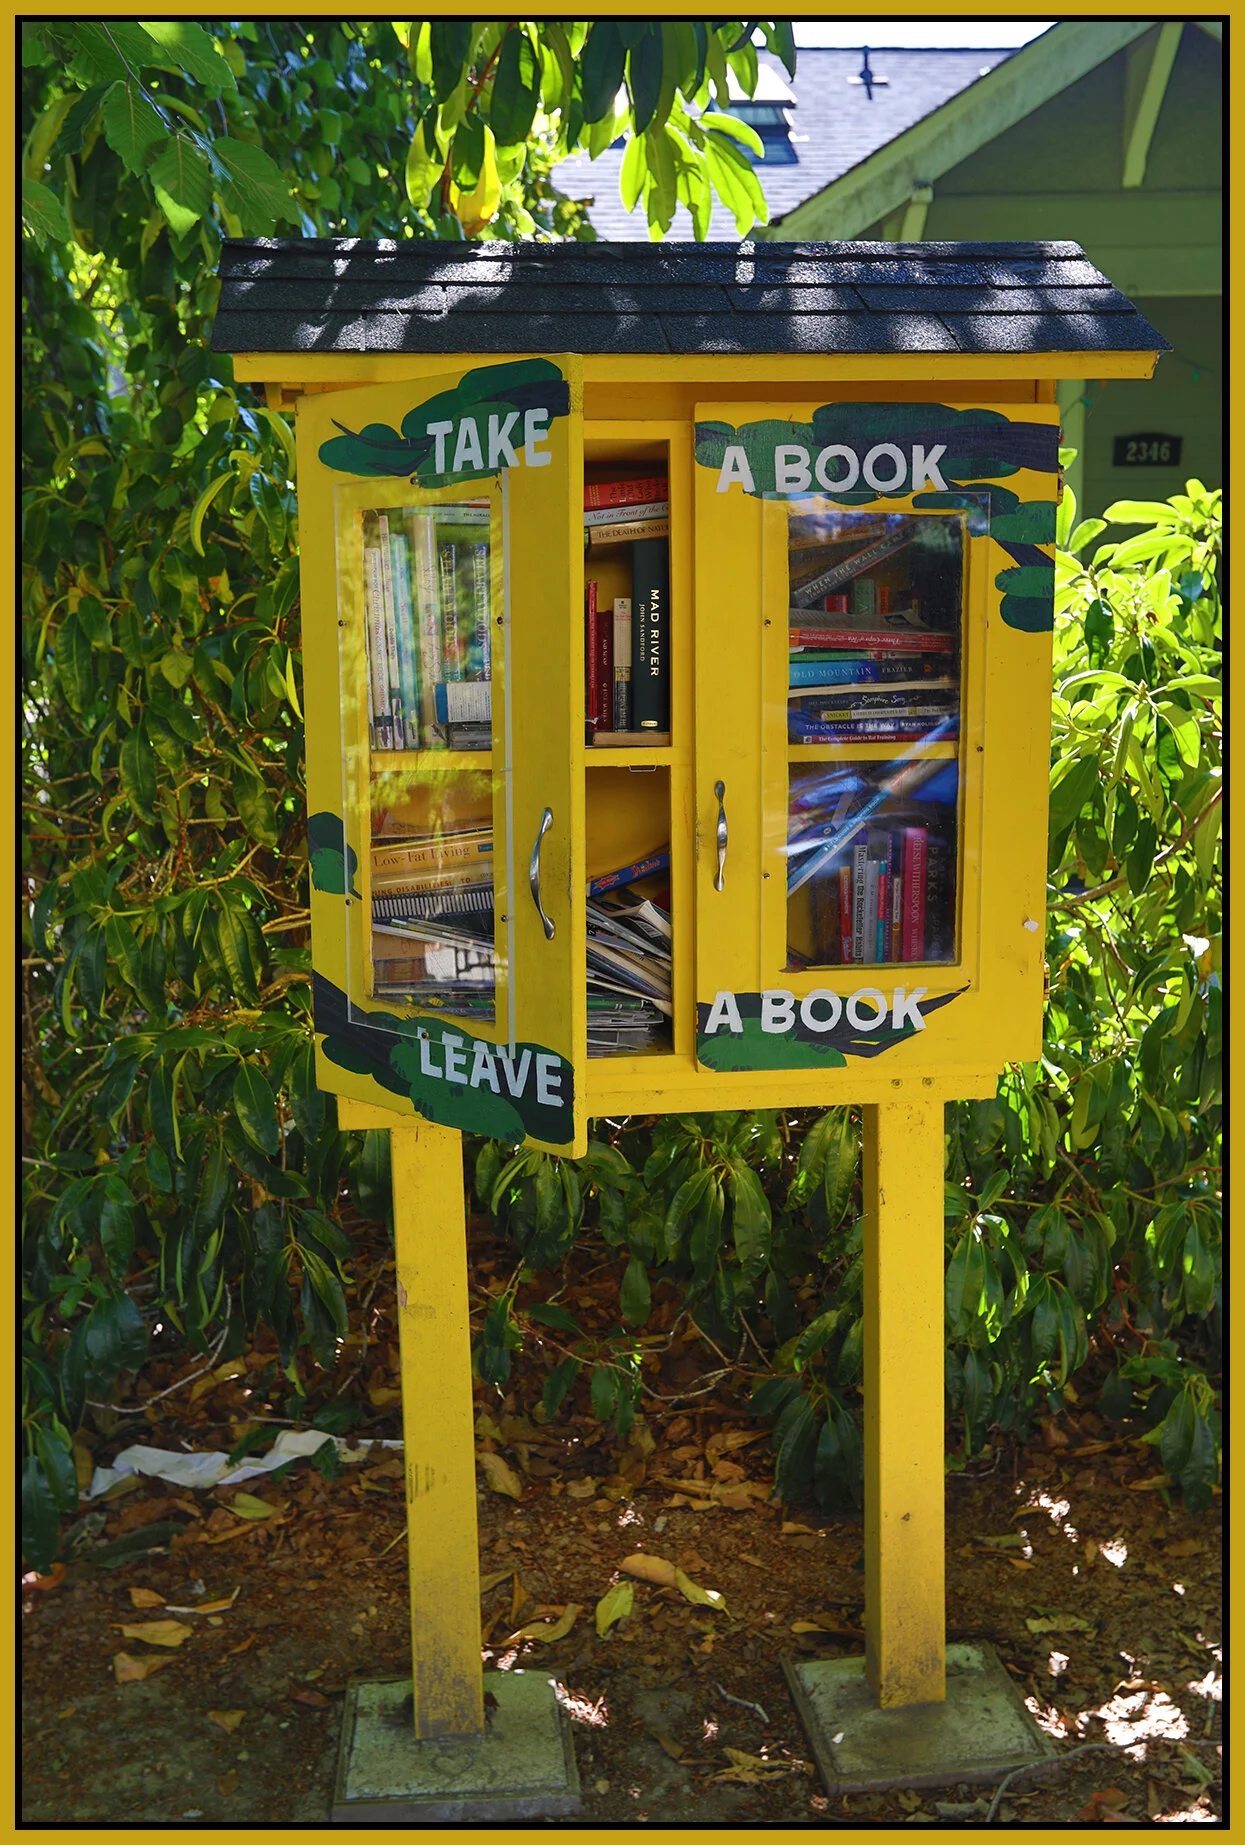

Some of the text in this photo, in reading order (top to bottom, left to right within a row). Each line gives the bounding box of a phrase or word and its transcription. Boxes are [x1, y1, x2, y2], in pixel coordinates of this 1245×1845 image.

[426, 408, 552, 474] TAKE
[1125, 441, 1171, 462] 2346
[716, 443, 949, 493] A BOOK
[588, 512, 604, 521] Not
[616, 508, 638, 518] Front
[640, 506, 648, 517] of
[648, 504, 660, 514] the
[598, 530, 612, 539] THE
[612, 527, 636, 537] DEATH
[636, 525, 646, 534] OF
[804, 577, 831, 595] WHEN
[833, 564, 851, 578] THE
[853, 549, 878, 565] WALL
[638, 603, 646, 623] JOHN
[650, 589, 661, 677] MAD RIVER
[848, 636, 859, 644] Tea
[864, 635, 880, 646] Cups
[879, 637, 900, 646] Three
[793, 666, 913, 678] OLD MOUNTAIN FRAZIER
[820, 723, 855, 731] OBSTACLE
[828, 735, 849, 743] Complete
[373, 851, 426, 867] Low-Fat
[430, 846, 470, 859] Living
[912, 837, 924, 862] REESE
[927, 847, 939, 903] PARKS
[854, 846, 866, 958] Mastering the Rockefeller Habits
[910, 863, 922, 923] WITHERSPOON
[704, 987, 928, 1034] A BOOK
[417, 1026, 565, 1107] LEAVE
